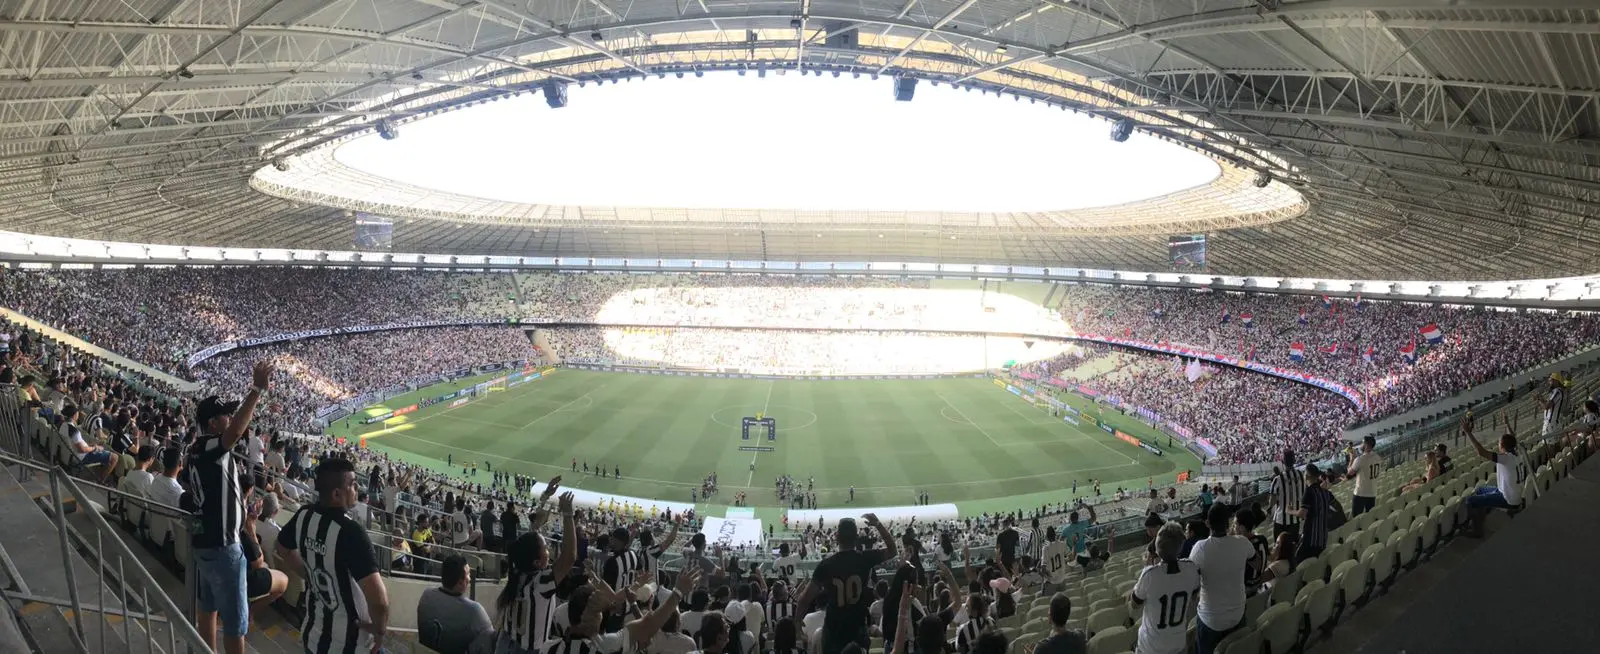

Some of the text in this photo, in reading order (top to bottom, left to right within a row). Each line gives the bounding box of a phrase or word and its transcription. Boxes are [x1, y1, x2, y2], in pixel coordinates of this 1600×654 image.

[1368, 463, 1380, 480] 10
[779, 564, 794, 576] 10
[1051, 553, 1062, 572] 10
[832, 575, 863, 607] 10
[1157, 591, 1188, 630] 10
